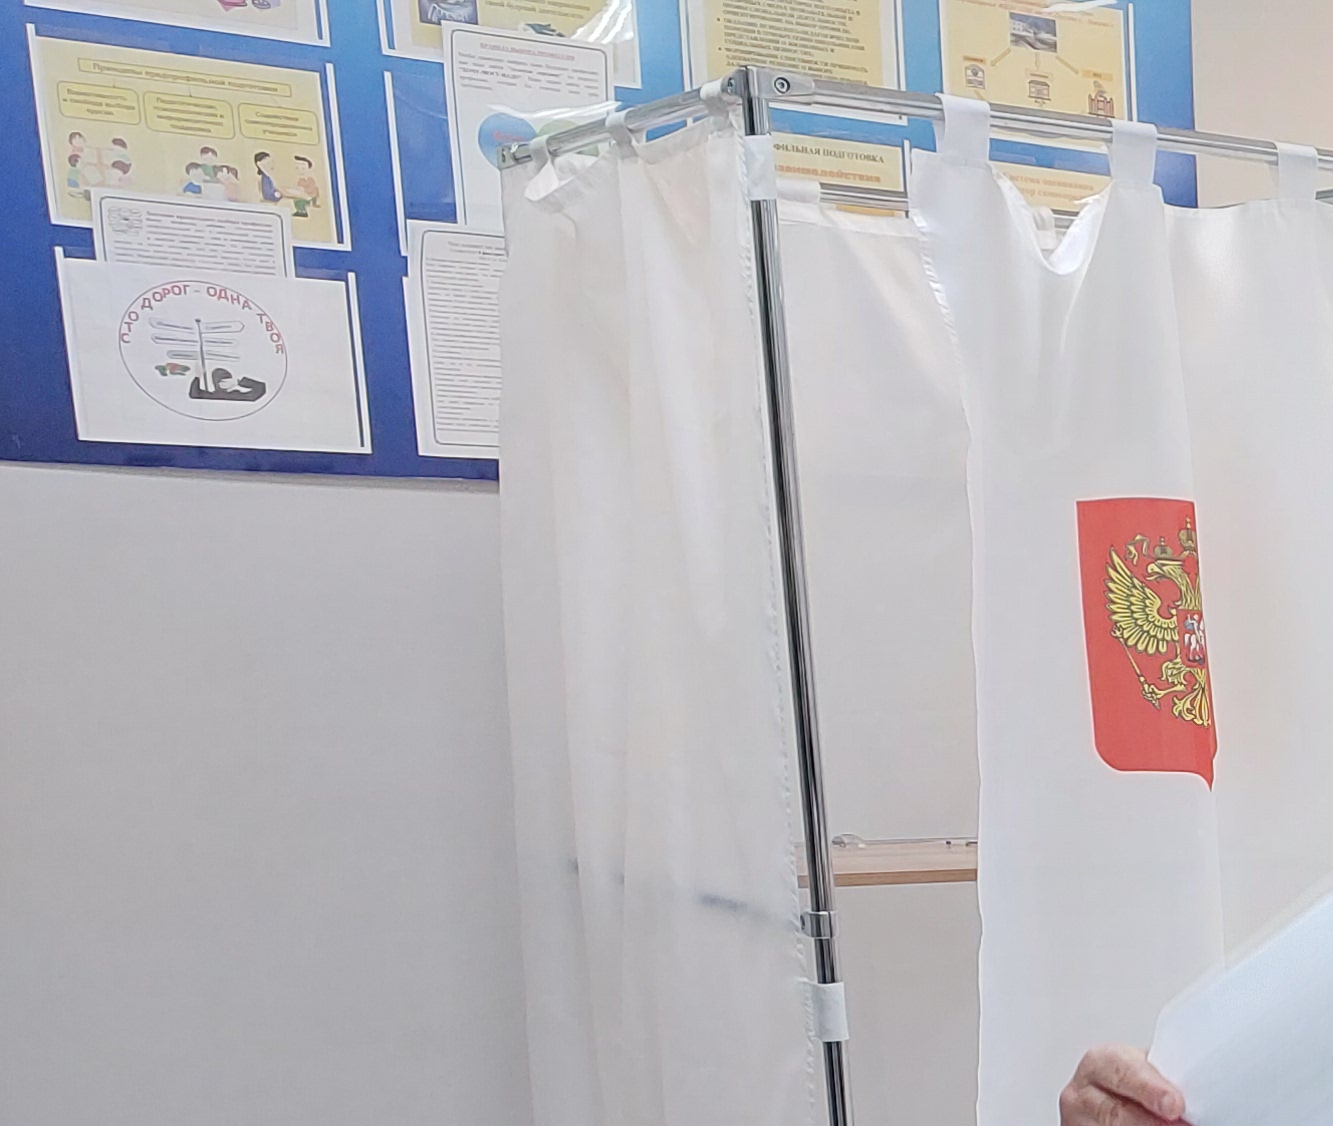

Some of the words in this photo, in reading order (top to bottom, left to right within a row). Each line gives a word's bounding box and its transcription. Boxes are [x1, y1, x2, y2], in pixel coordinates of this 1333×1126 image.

[822, 149, 885, 164] ПОДГОТОВКА
[120, 311, 140, 345] СТО
[140, 284, 191, 311] ДОРОГ
[206, 286, 252, 311] ОДНА
[256, 312, 285, 355] ТВОЯ
